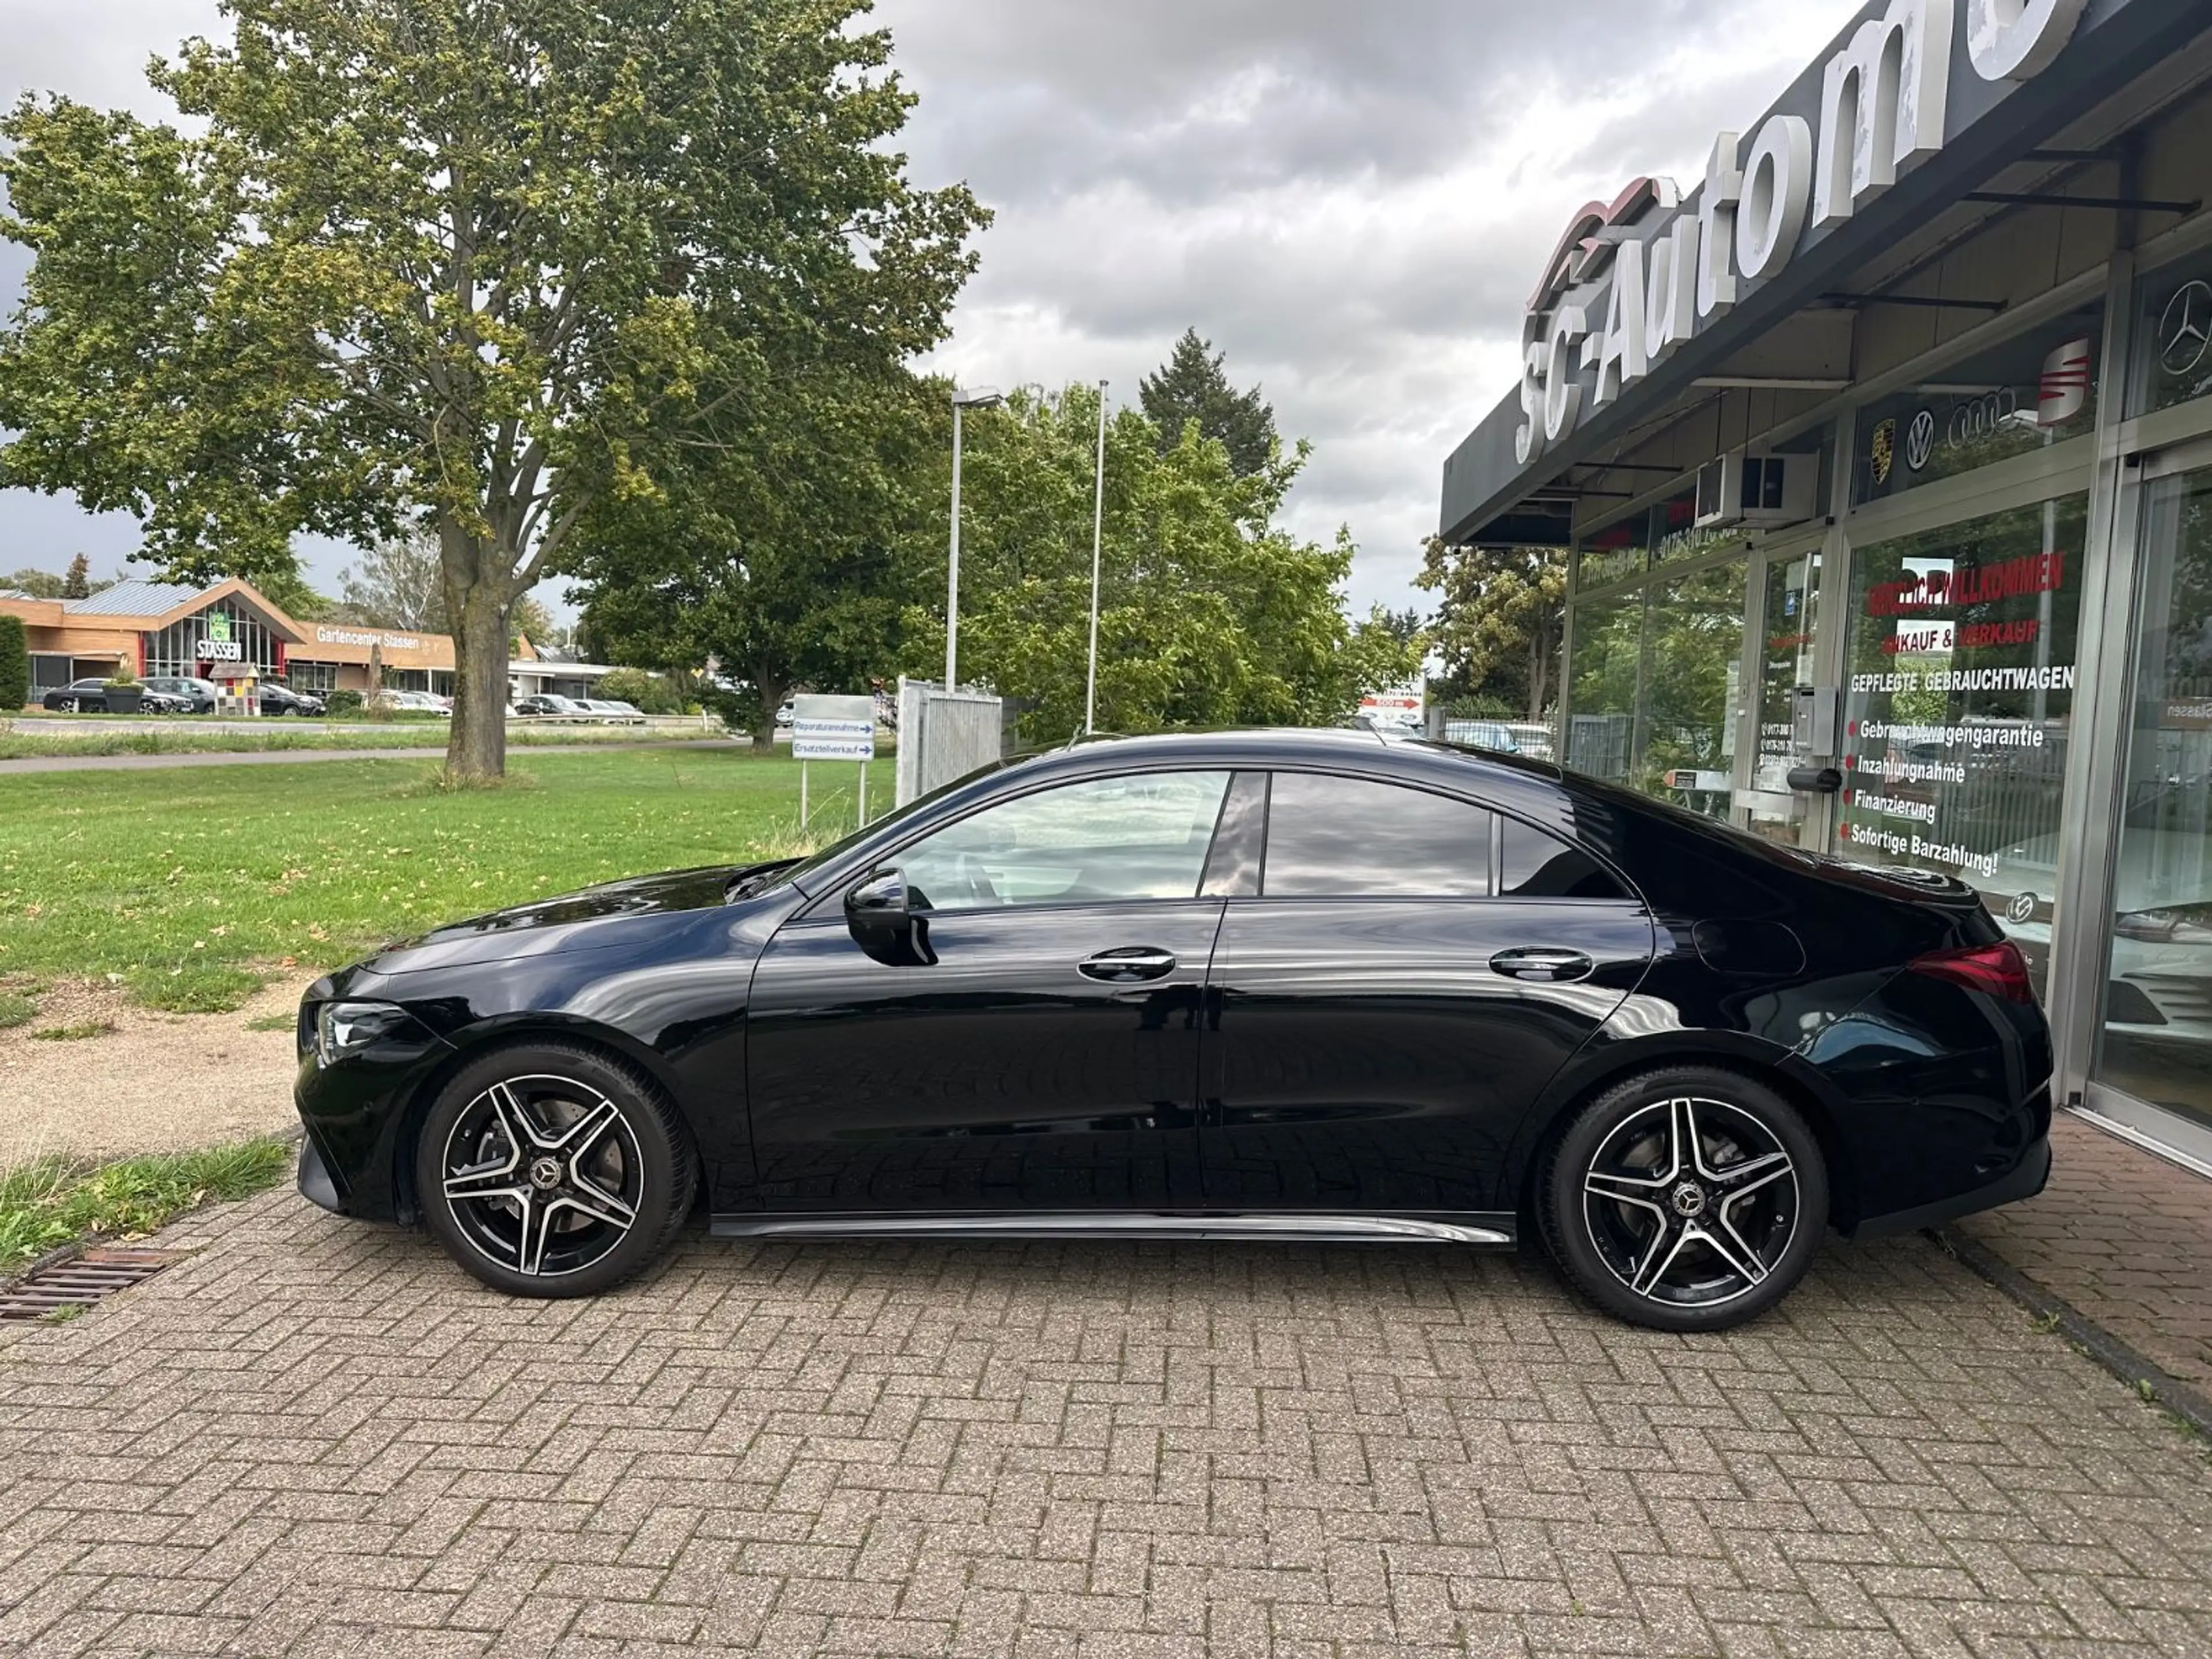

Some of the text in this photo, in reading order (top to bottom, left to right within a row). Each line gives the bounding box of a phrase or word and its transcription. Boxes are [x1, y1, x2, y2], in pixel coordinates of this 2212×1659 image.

[197, 639, 241, 661] STASSEN
[317, 626, 419, 649] Gartencenter Stassen
[1942, 628, 1952, 648] &
[1851, 665, 2075, 692] GEPFLEGTE GEBRAUCHTWAGEN
[1860, 720, 2043, 749] Gebrauchtwagengarantie
[1858, 755, 1965, 783] Inzahlungnahme
[1854, 789, 1936, 824] Finanzierung
[1851, 824, 1999, 877] Sofortige Barzahlung!
